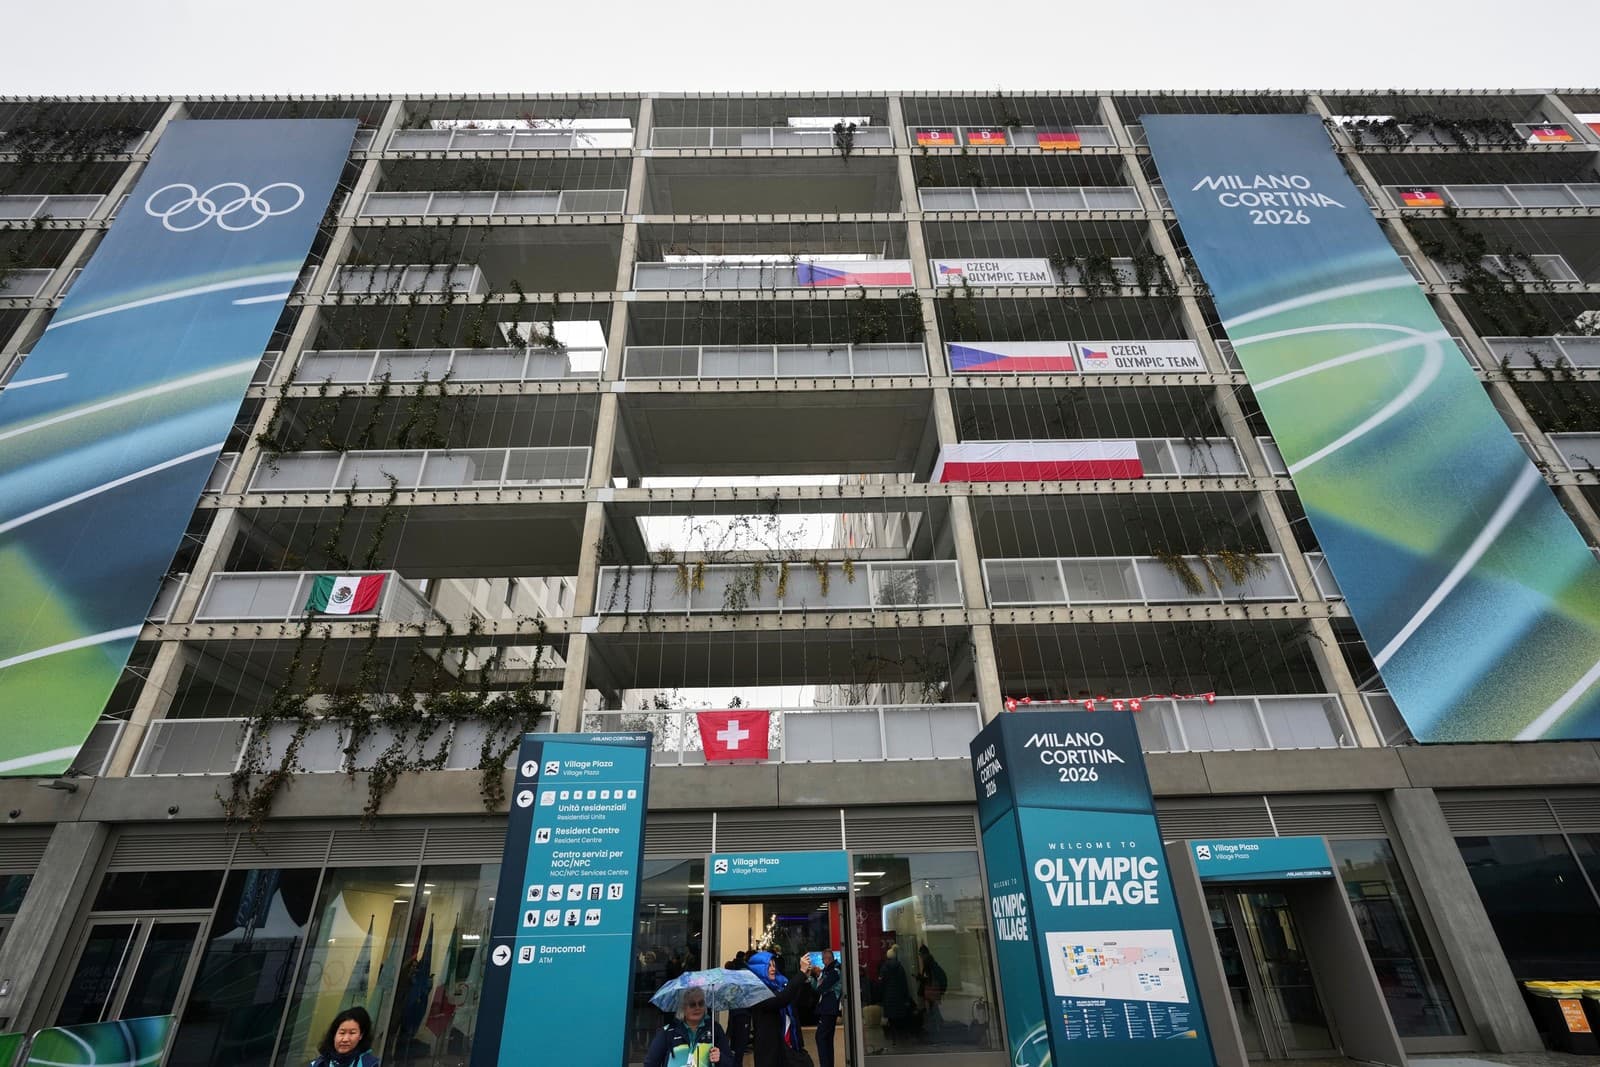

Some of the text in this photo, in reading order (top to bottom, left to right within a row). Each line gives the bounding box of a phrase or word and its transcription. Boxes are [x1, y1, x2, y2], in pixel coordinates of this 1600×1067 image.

[1192, 174, 1311, 191] MILANO
[1218, 192, 1347, 209] CORTINA
[1250, 210, 1311, 225] 2026
[966, 262, 1000, 271] CZECH
[968, 272, 1047, 282] OLYMPIC TEAM
[1111, 345, 1146, 356] CZECH
[1115, 357, 1199, 368] OLYMPIC TEAM
[1024, 732, 1104, 748] MILANO
[976, 744, 996, 771] MILANO
[1040, 749, 1125, 764] CORTINA
[564, 761, 591, 769] Village
[980, 759, 1003, 784] CORTINA
[1058, 767, 1099, 782] 2026
[985, 781, 997, 797] 2026
[558, 803, 626, 812] Unità residenziali
[1049, 842, 1112, 850] WELCOME
[1213, 844, 1239, 853] Village
[552, 850, 624, 859] Centro servizi per
[732, 859, 758, 867] Village
[1034, 857, 1160, 882] OLYMPIC
[1045, 881, 1160, 907] VILLAGE
[992, 893, 1027, 918] OLYMPIC
[996, 917, 1029, 941] VILLAGE
[540, 945, 586, 953] Bancomat
